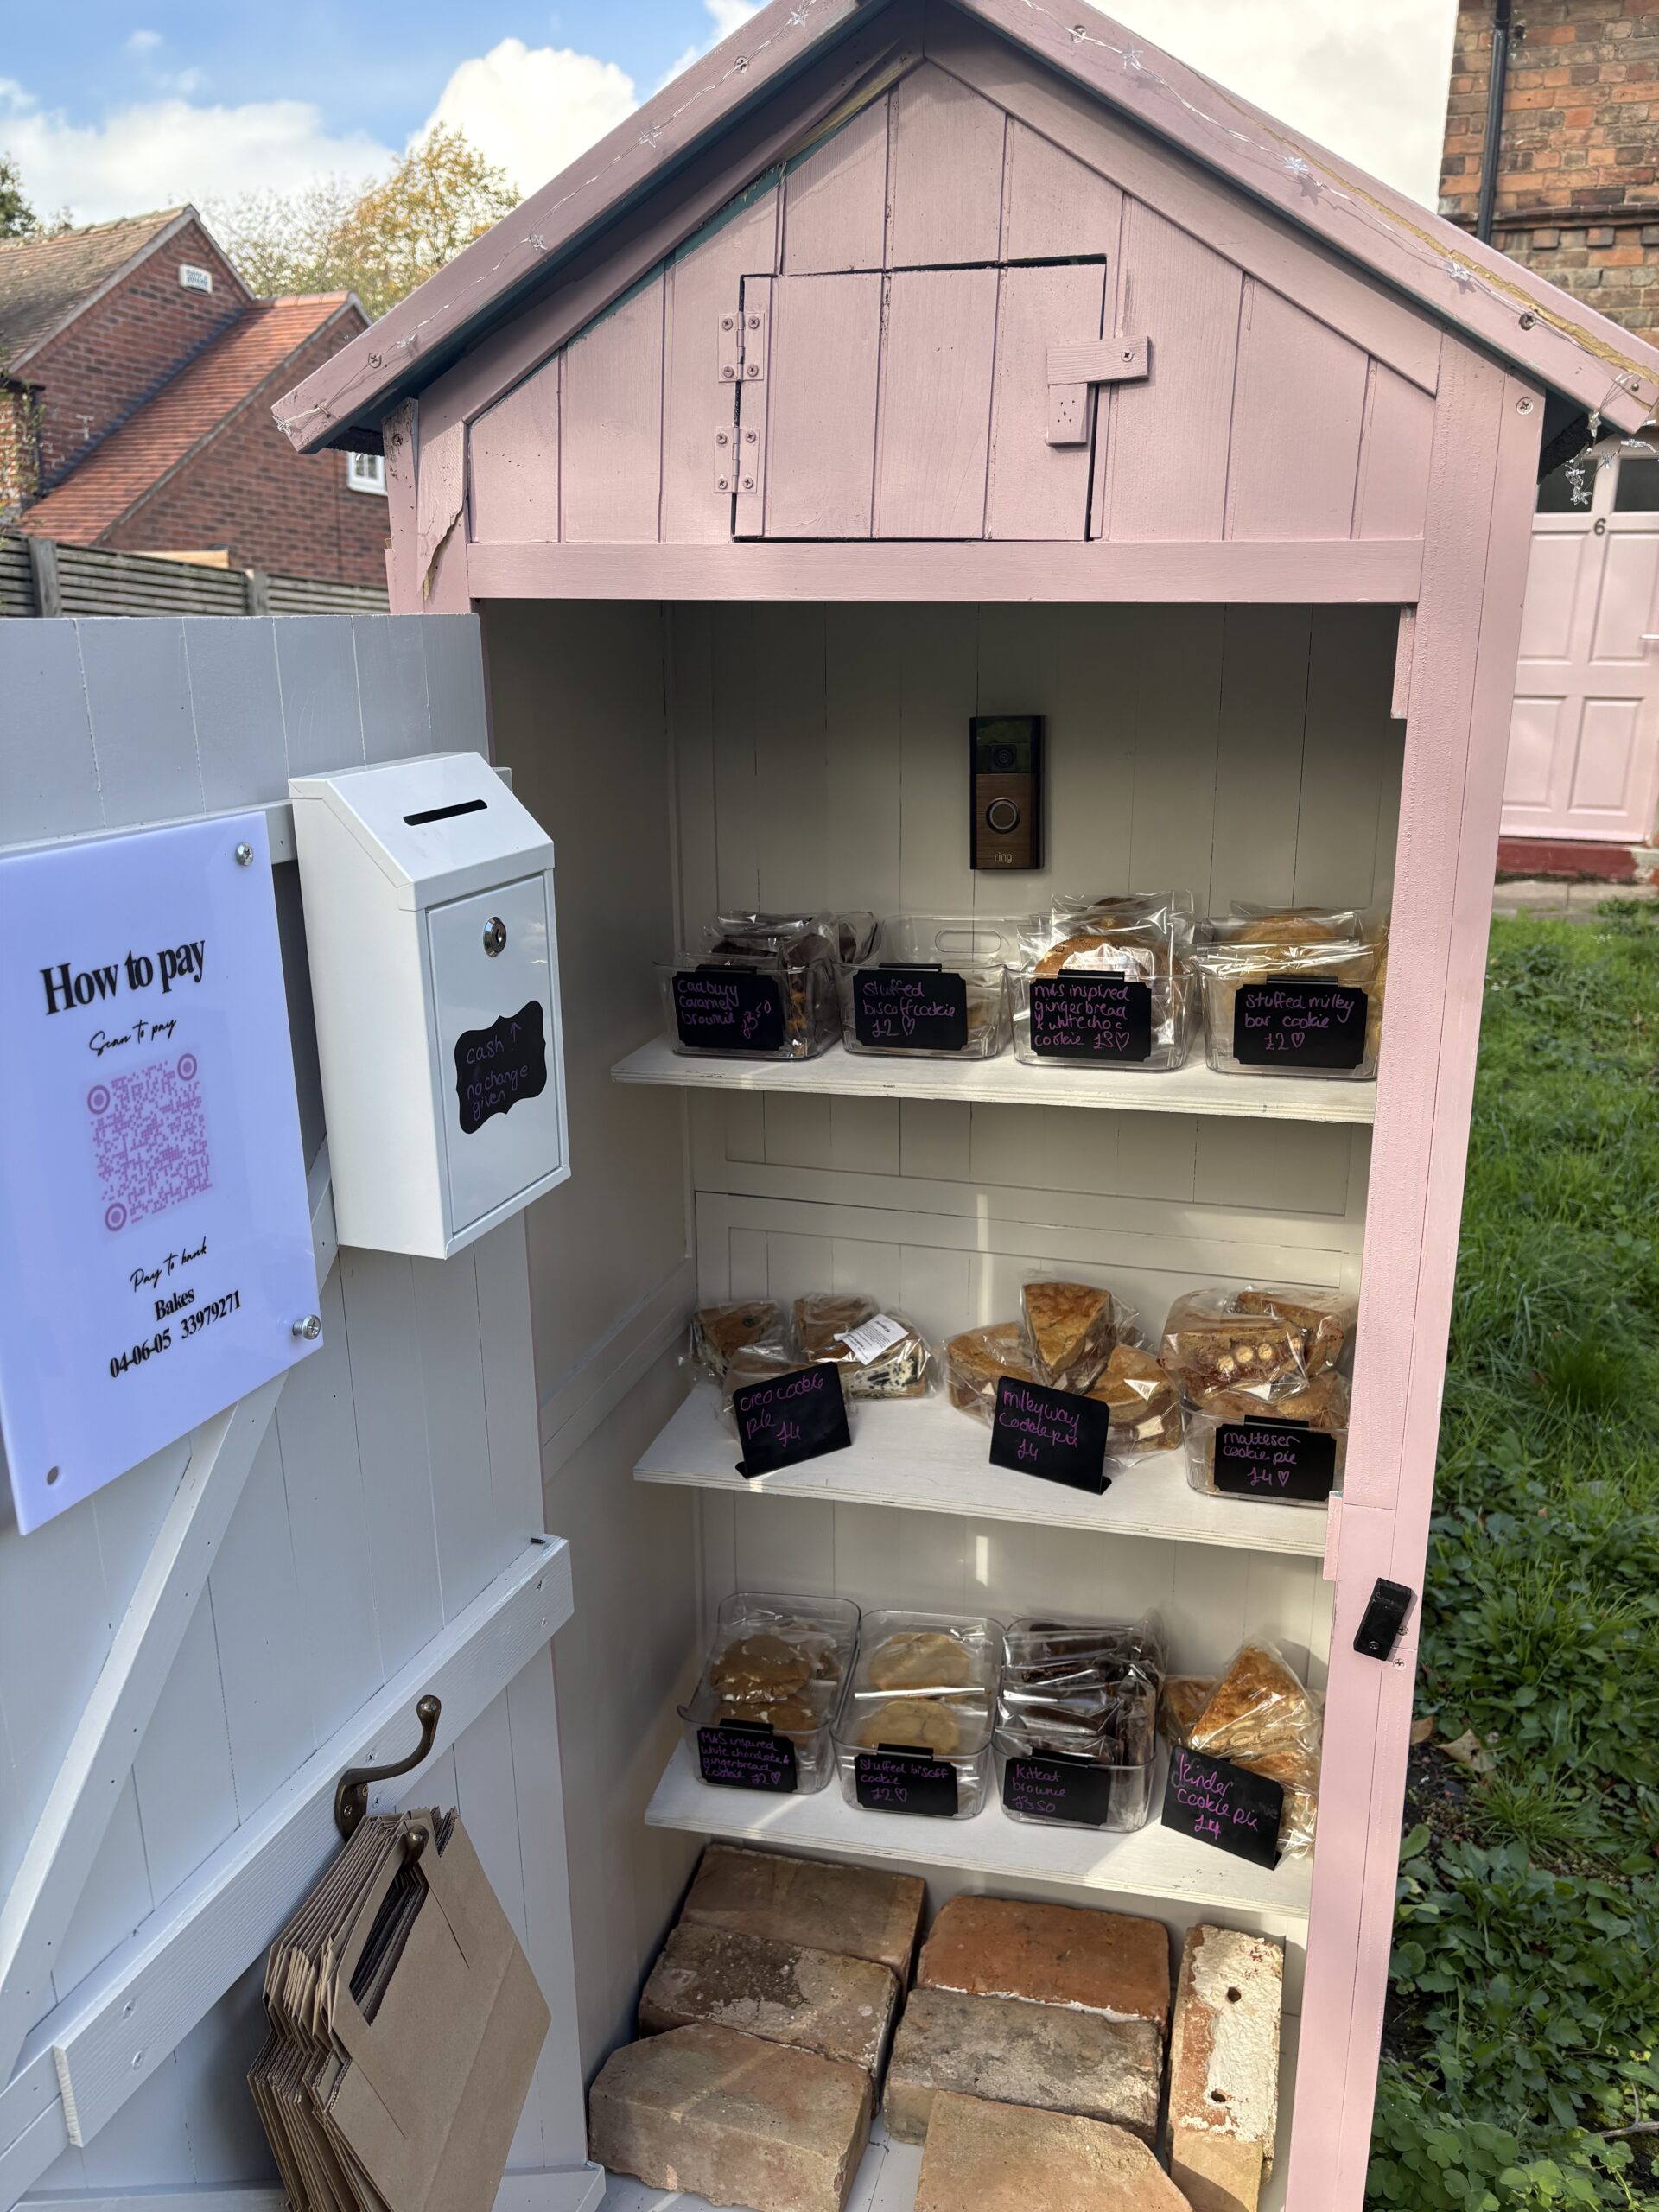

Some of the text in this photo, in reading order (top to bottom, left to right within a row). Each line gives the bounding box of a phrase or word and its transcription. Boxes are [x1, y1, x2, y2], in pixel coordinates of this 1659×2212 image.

[1593, 518, 1606, 536] 6
[994, 851, 1013, 863] ring
[39, 940, 206, 1016] How to pay
[1069, 983, 1131, 1001] inspired
[871, 1019, 899, 1038] £2
[1244, 1011, 1331, 1029] bar cookie
[88, 1019, 177, 1057] Scan to pay
[1264, 1032, 1290, 1051] £2
[466, 1034, 505, 1065] cash
[472, 1089, 506, 1122] given
[130, 1236, 207, 1293] Pay to bank
[154, 1288, 195, 1321] Bakes
[109, 1289, 242, 1378] 04-06-05 33979271
[1272, 1450, 1298, 1465] pie
[1247, 1466, 1273, 1487] £4
[729, 1736, 779, 1751] inspired
[870, 1787, 894, 1801] £2
